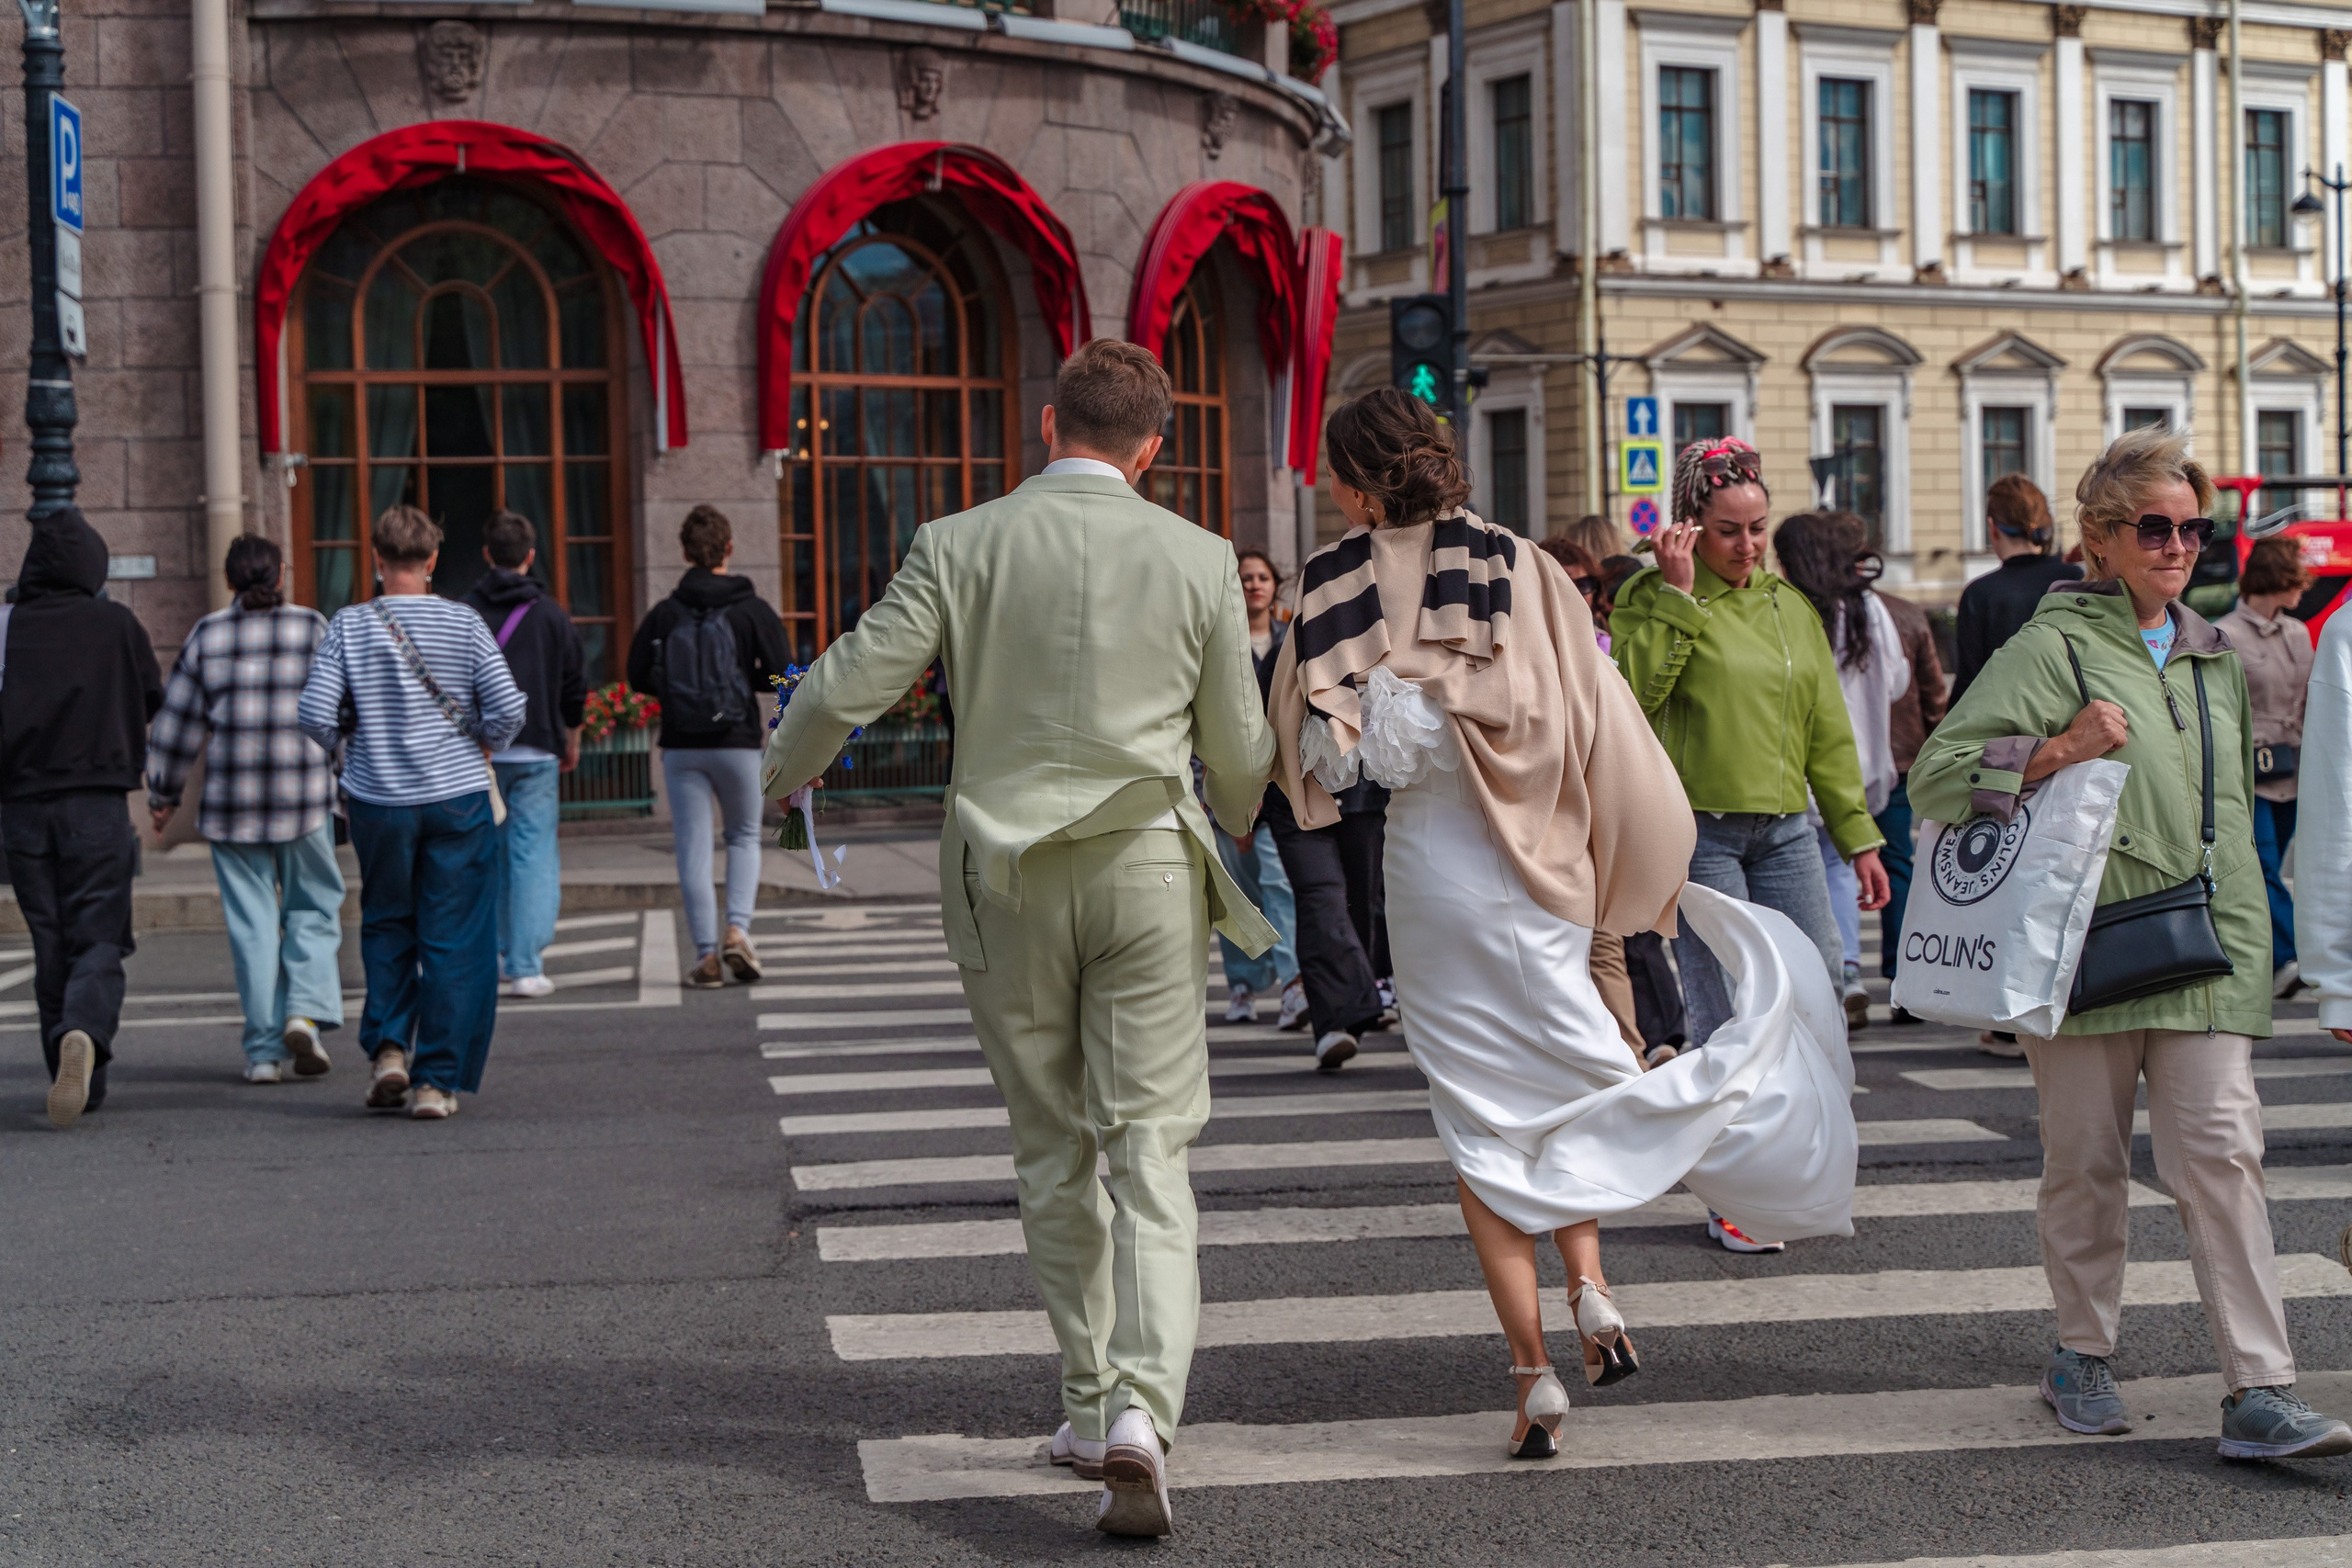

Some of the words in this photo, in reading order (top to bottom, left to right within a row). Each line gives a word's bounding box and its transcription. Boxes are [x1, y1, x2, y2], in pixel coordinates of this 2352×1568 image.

[60, 114, 77, 209] P
[1940, 823, 1974, 895] JEANSWEA
[1980, 823, 2019, 887] COLIN'S
[1905, 931, 1996, 972] COLIN'S
